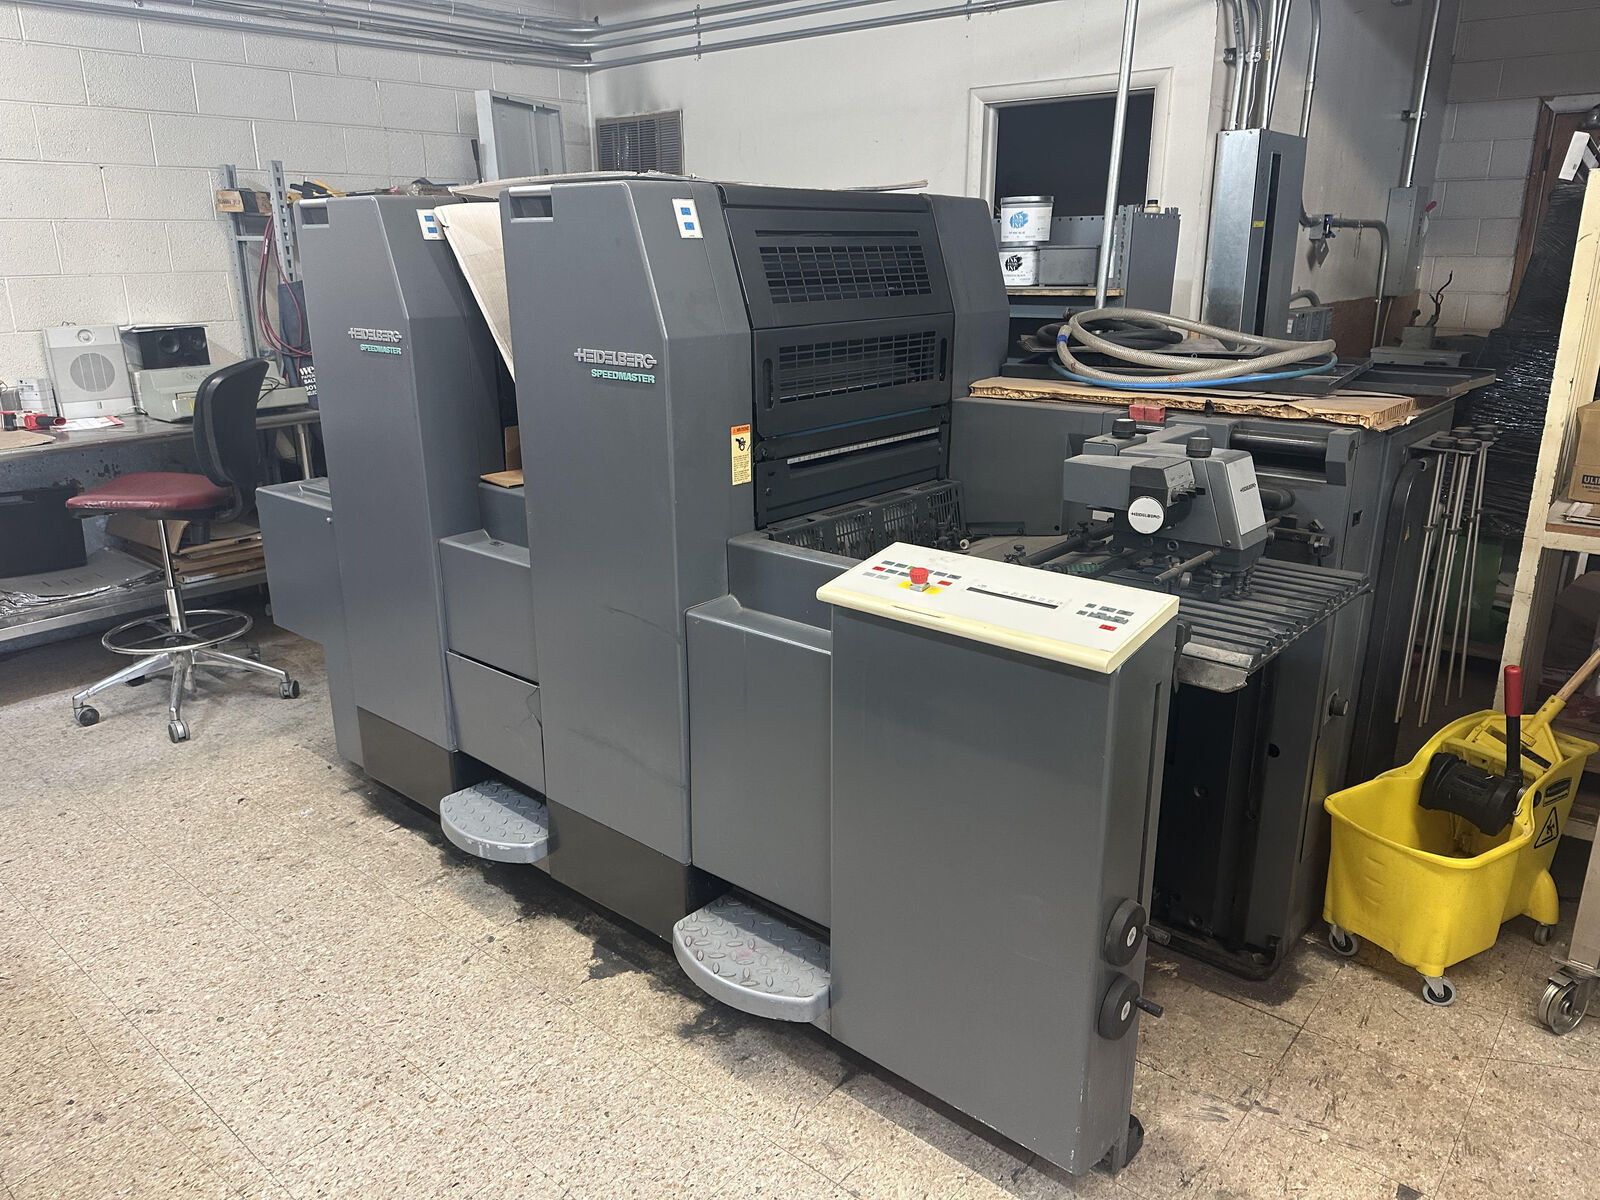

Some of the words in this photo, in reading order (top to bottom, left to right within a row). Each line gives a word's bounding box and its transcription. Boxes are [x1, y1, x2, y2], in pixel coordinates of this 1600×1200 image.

[348, 327, 402, 342] HEIDELBERG
[360, 343, 402, 355] SPEEDMASTER
[574, 347, 657, 369] HEIDELBERG
[591, 368, 656, 384] SPEEDMASTER
